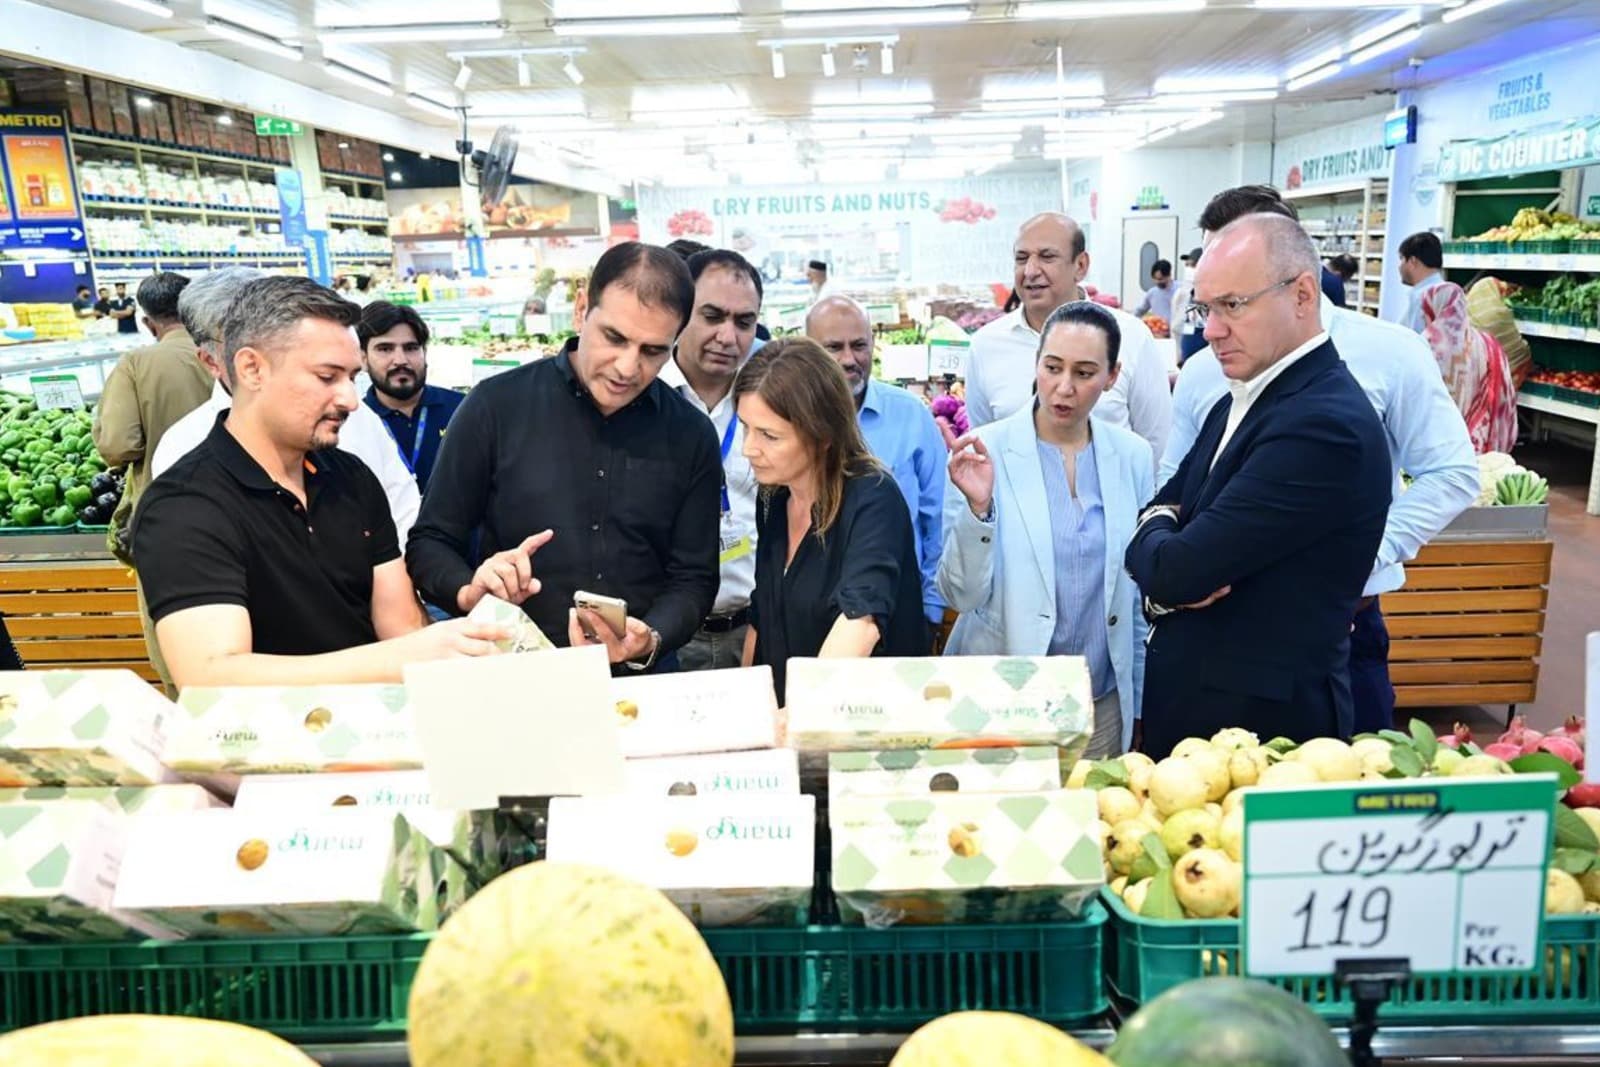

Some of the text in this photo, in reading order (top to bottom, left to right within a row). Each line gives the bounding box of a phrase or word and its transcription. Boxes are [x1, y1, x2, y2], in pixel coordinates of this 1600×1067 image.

[1498, 72, 1544, 99] FRUITS &
[1488, 92, 1552, 121] VEGETABLES
[0, 114, 62, 127] METRO
[1303, 158, 1319, 182] DRY
[1321, 149, 1358, 179] FRUITS
[1360, 144, 1384, 172] AND
[1459, 127, 1588, 174] DC COUNTER
[713, 190, 931, 216] DRY FRUITS AND NUTS
[1286, 886, 1392, 952] 119
[1465, 923, 1498, 938] Per
[1465, 946, 1526, 967] KG.
